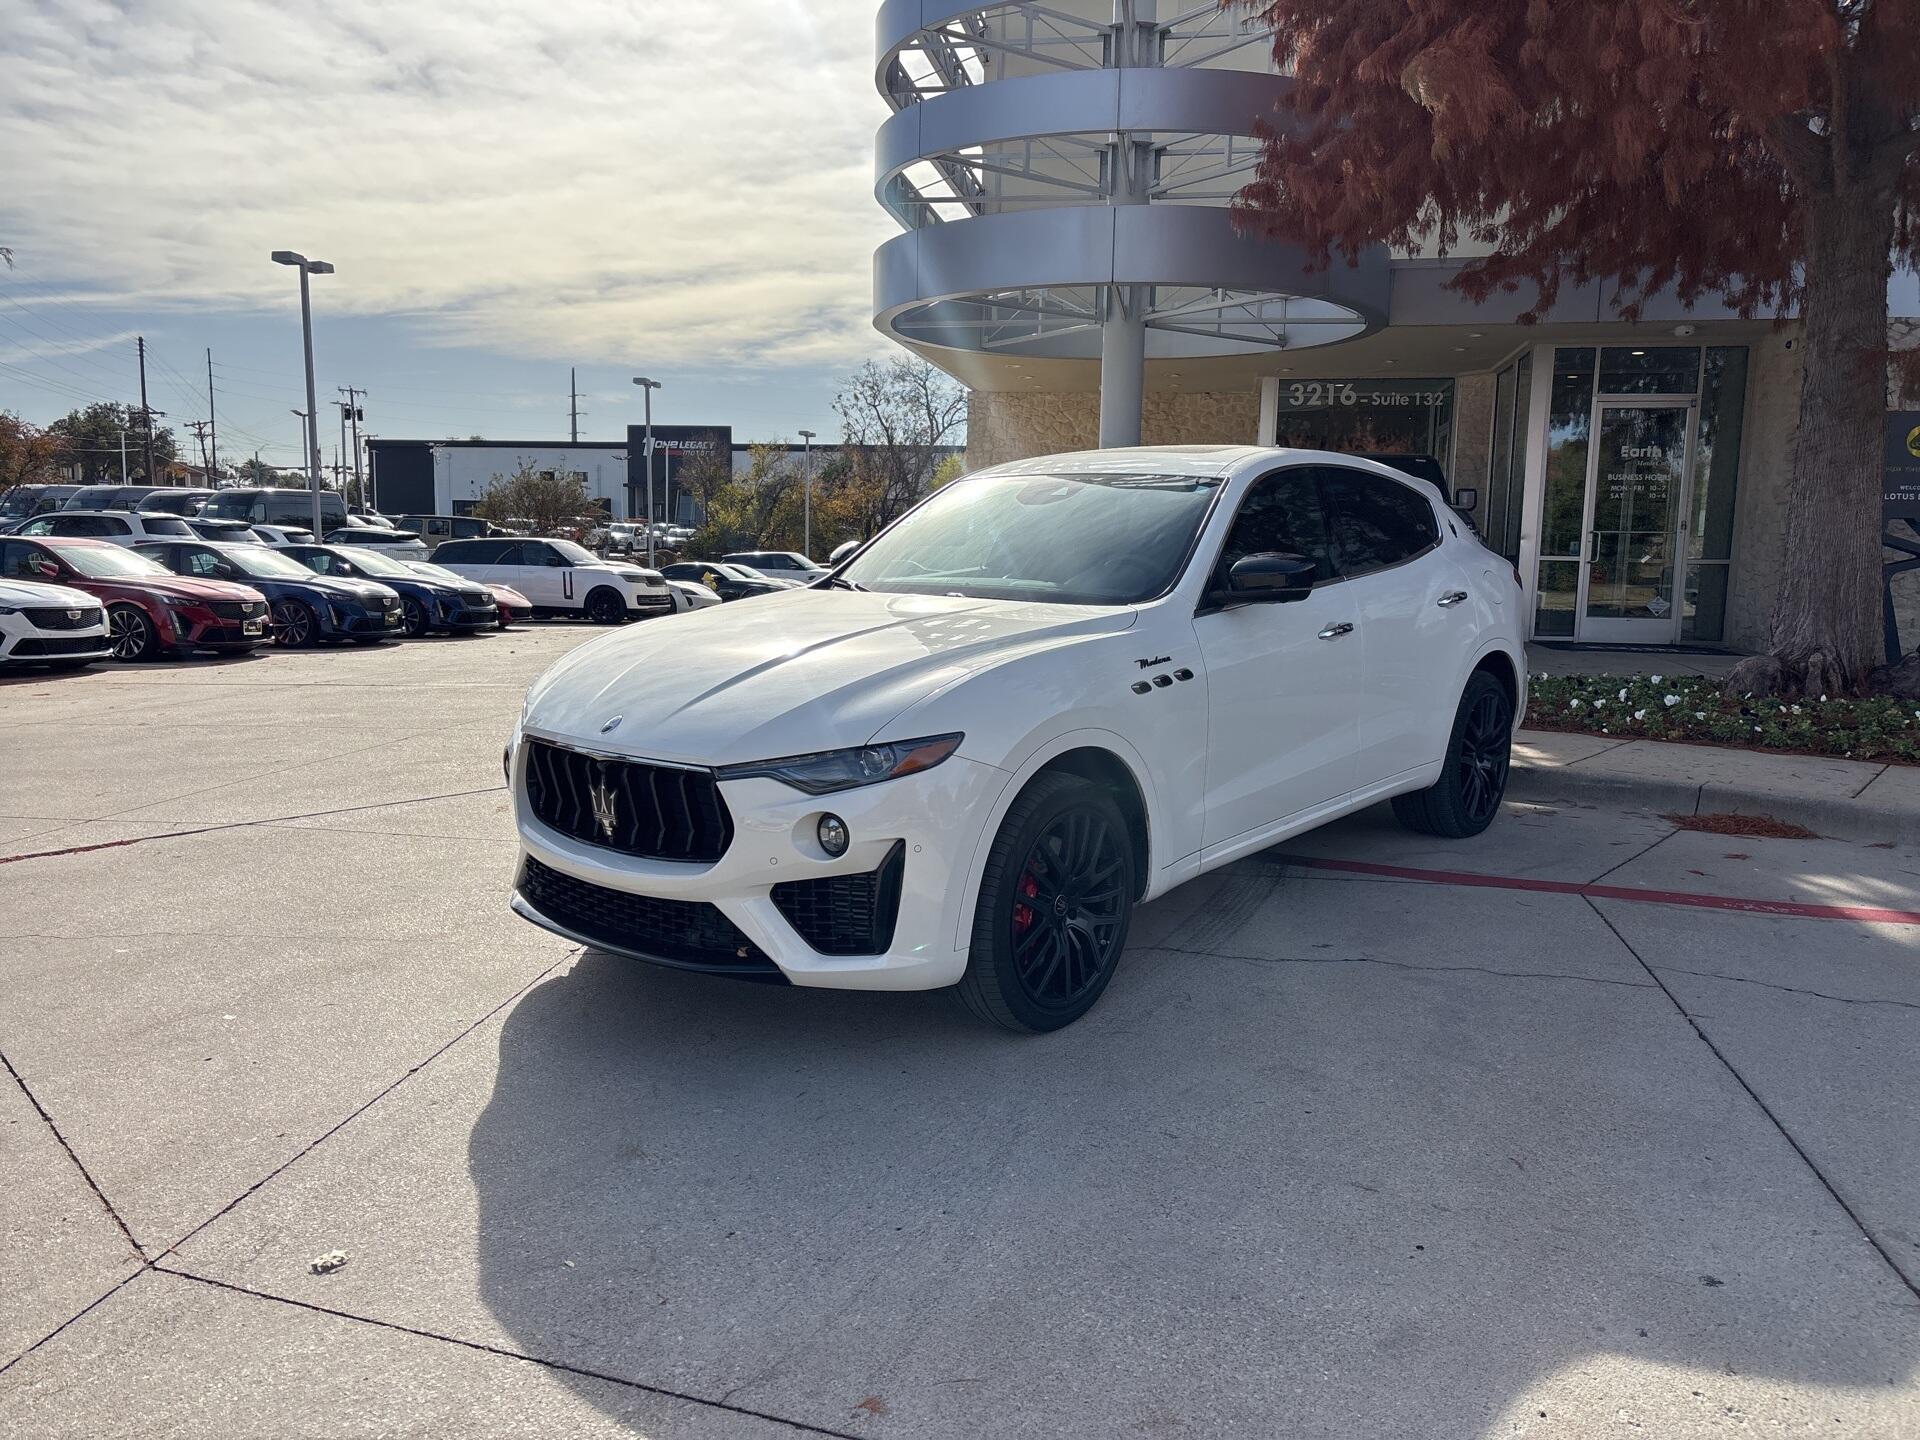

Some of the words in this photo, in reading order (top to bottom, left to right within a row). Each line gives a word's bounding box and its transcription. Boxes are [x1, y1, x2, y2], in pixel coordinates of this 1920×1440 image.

[1289, 384, 1357, 406] 3216
[1372, 392, 1409, 406] Suite
[1414, 392, 1444, 406] 132
[1620, 445, 1662, 458] Earth
[1607, 473, 1643, 481] BUSINESS
[1884, 493, 1915, 501] LOTUS
